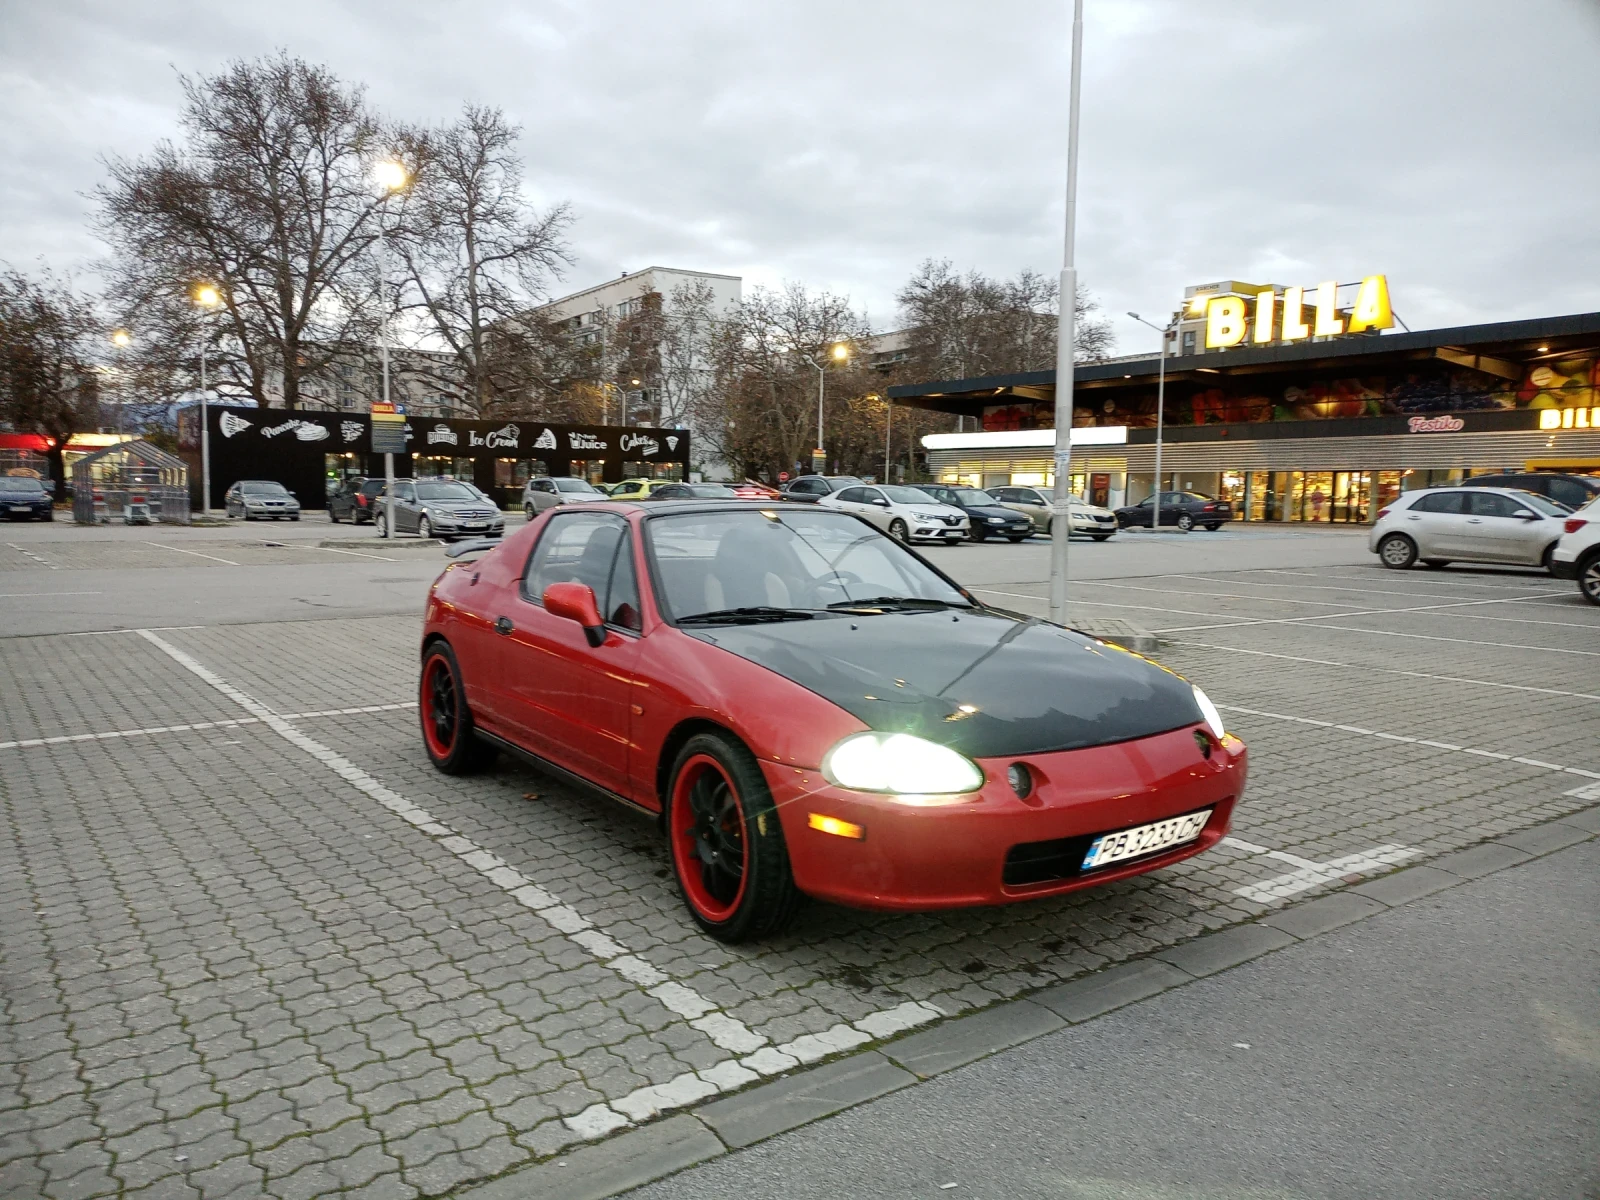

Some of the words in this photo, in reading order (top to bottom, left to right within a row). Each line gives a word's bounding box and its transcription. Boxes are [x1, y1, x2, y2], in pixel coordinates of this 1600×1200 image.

[1206, 274, 1395, 349] BILLA
[397, 405, 404, 413] P
[1408, 415, 1464, 433] Festiko
[468, 430, 485, 447] Ice
[485, 431, 519, 449] Cream
[580, 439, 608, 450] Juice
[1098, 833, 1129, 862] PB
[1128, 821, 1178, 853] 3233
